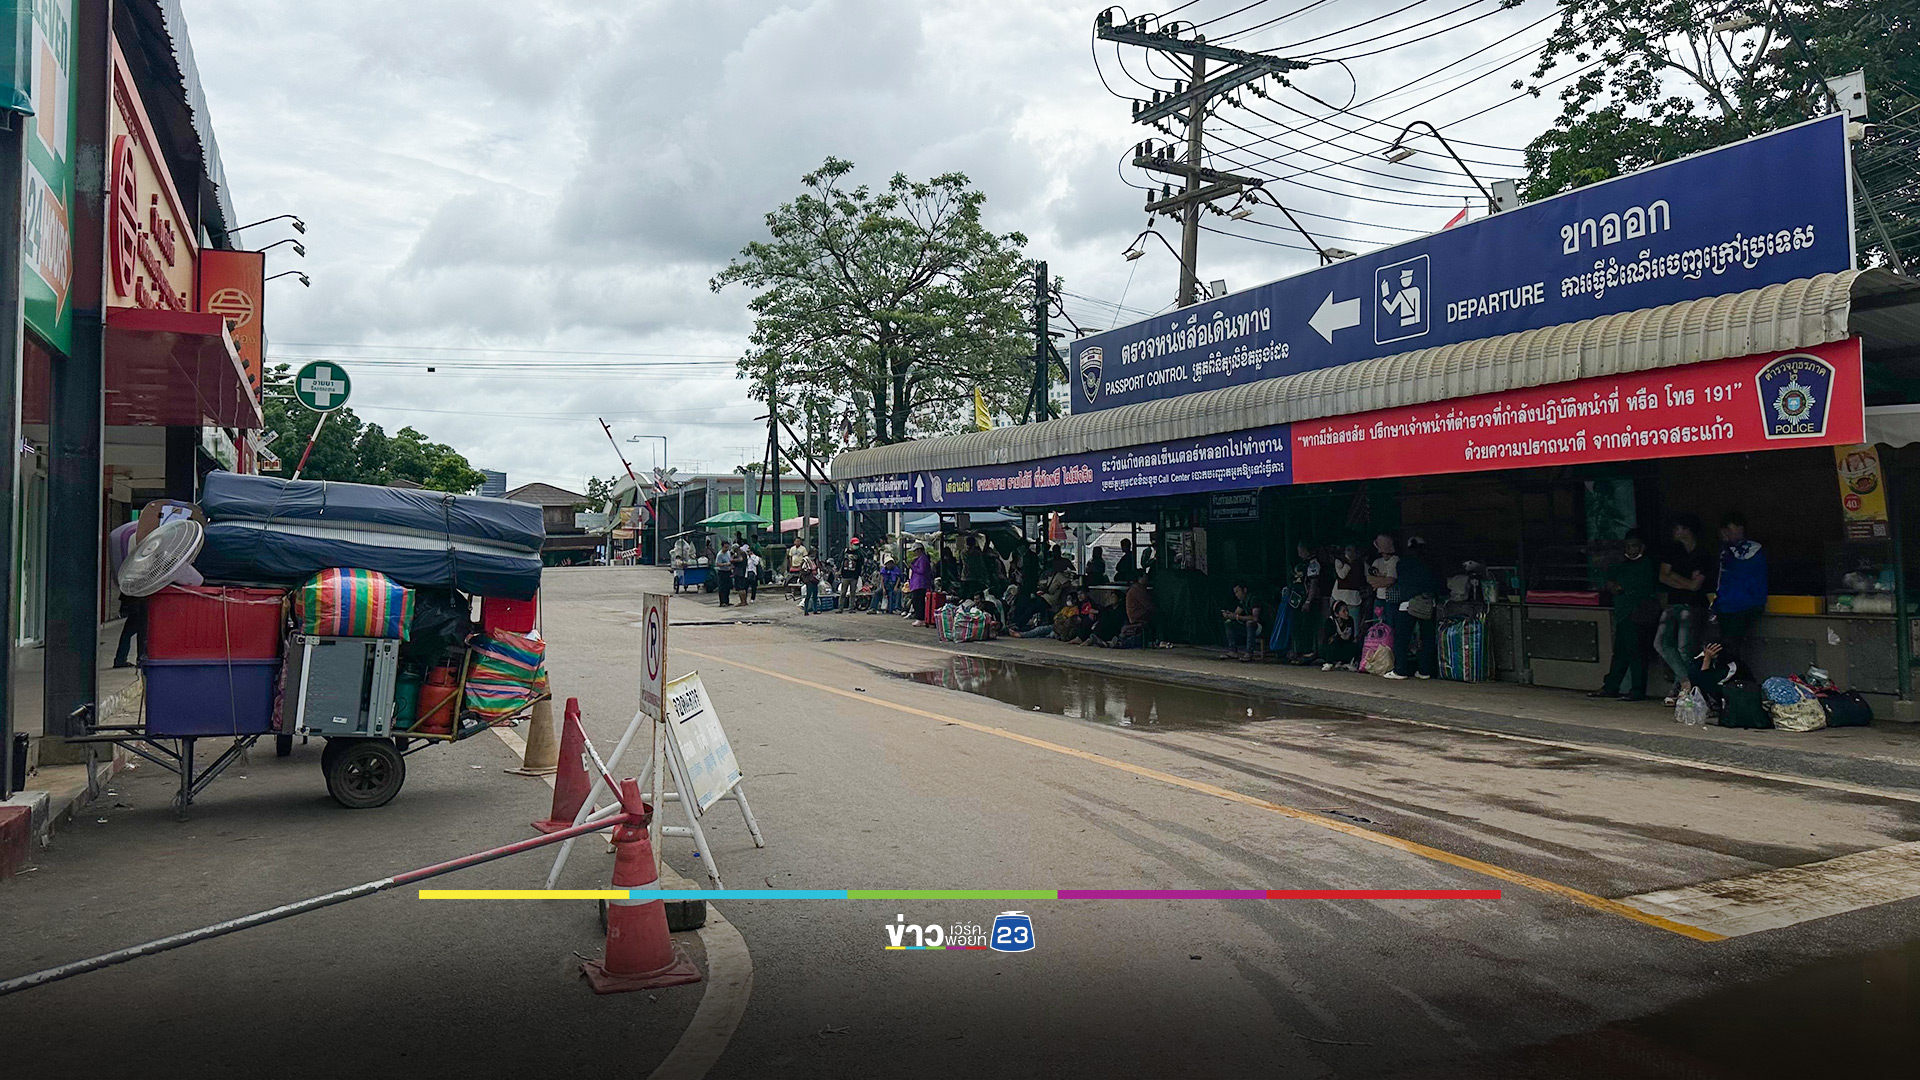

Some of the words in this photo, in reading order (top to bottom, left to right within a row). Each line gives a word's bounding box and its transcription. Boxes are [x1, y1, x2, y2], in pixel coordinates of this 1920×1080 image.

[26, 177, 43, 265] 24
[41, 199, 68, 291] HOURS
[1560, 199, 1671, 256] ขาออก
[1447, 281, 1545, 324] DEPARTURE
[1120, 305, 1272, 366] ตรวจหนังสือเดินทาง
[1105, 374, 1145, 397] PASSPORT
[1146, 365, 1188, 388] CONTROL
[1764, 361, 1828, 382] ตำรวจภูธรภาค
[1369, 386, 1619, 440] ปรึกษาเจ้าหน้าที่ตำรวจที่กำลังปฏิบัติหน้าที่
[1626, 387, 1659, 412] หรือ
[1665, 383, 1695, 408] โทร
[1775, 423, 1815, 434] POLICE
[1464, 428, 1587, 461] ด้วยความปราถนาดี
[1593, 415, 1734, 450] จากตำรวจสระแก้ว
[1158, 474, 1170, 484] Call
[1170, 473, 1191, 483] Center
